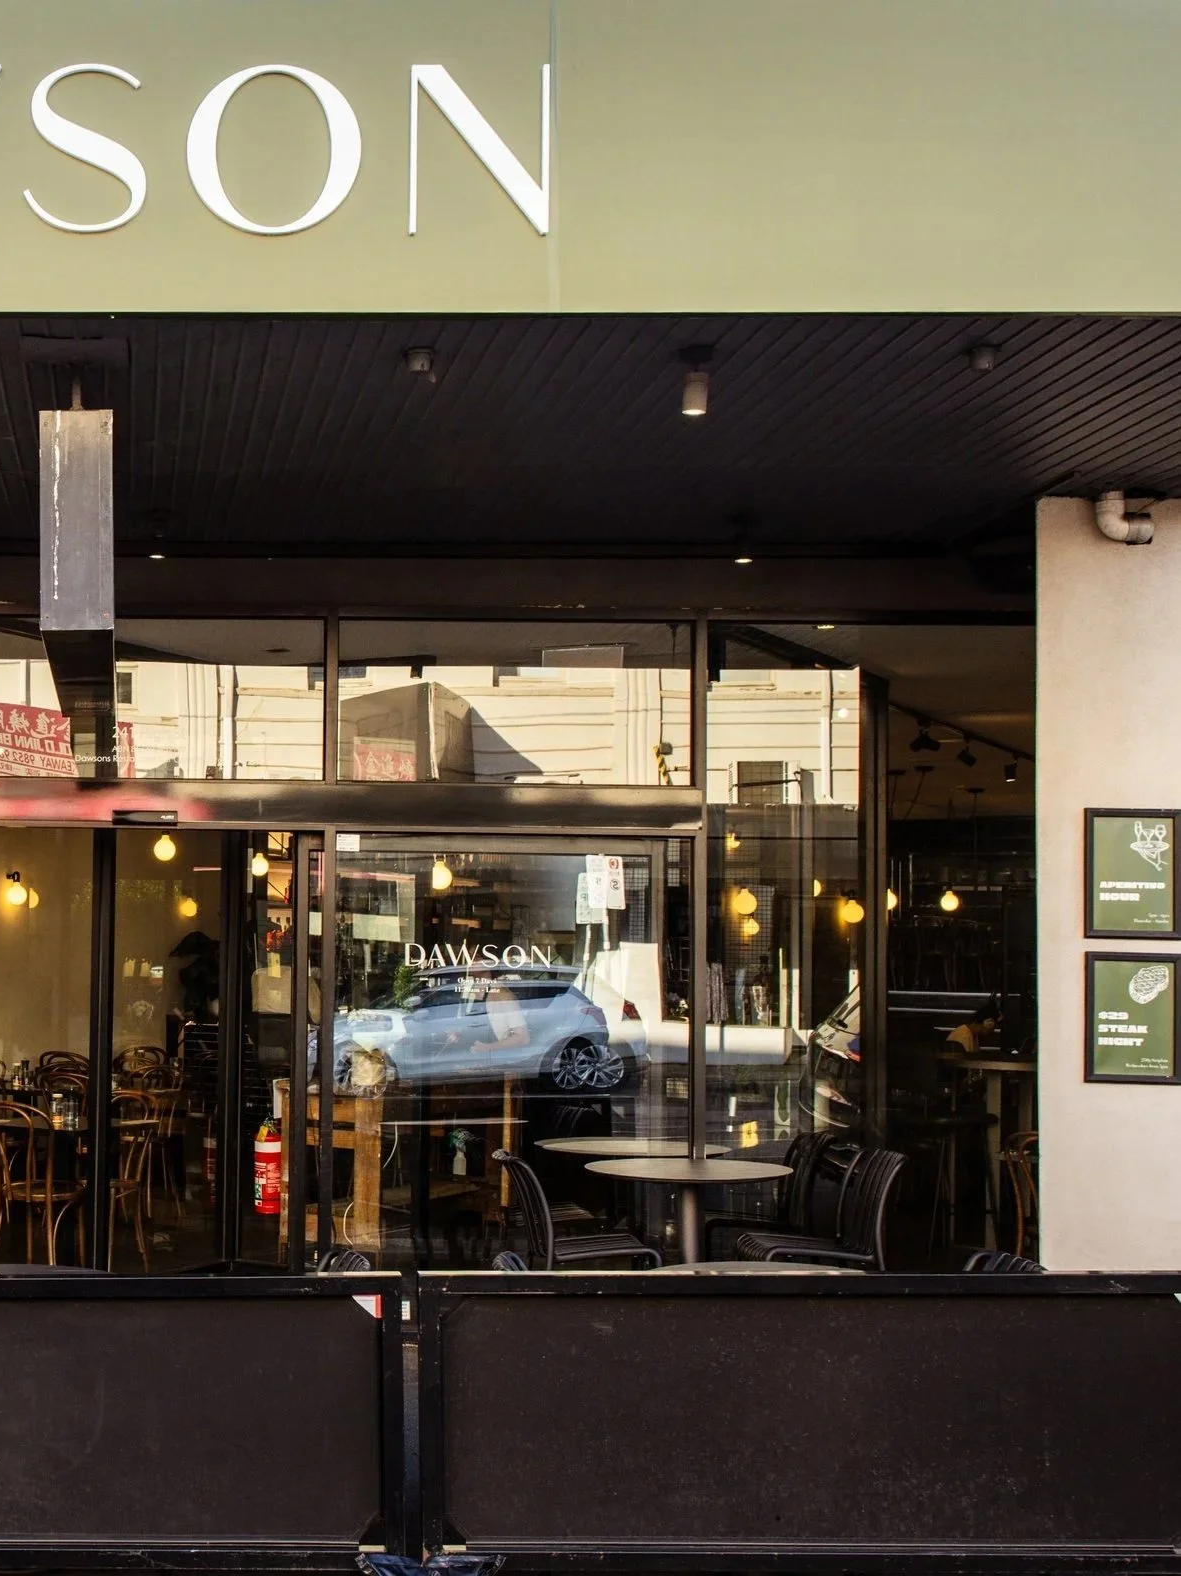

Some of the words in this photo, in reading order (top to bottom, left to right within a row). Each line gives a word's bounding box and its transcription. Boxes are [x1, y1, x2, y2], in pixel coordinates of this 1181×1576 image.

[1099, 880, 1166, 889] APERITIVO
[1099, 892, 1140, 902] HOUR
[404, 942, 551, 969] DAWSON
[481, 977, 498, 985] Days
[1098, 1024, 1148, 1034] STEAK
[1097, 1036, 1144, 1047] NIGHT
